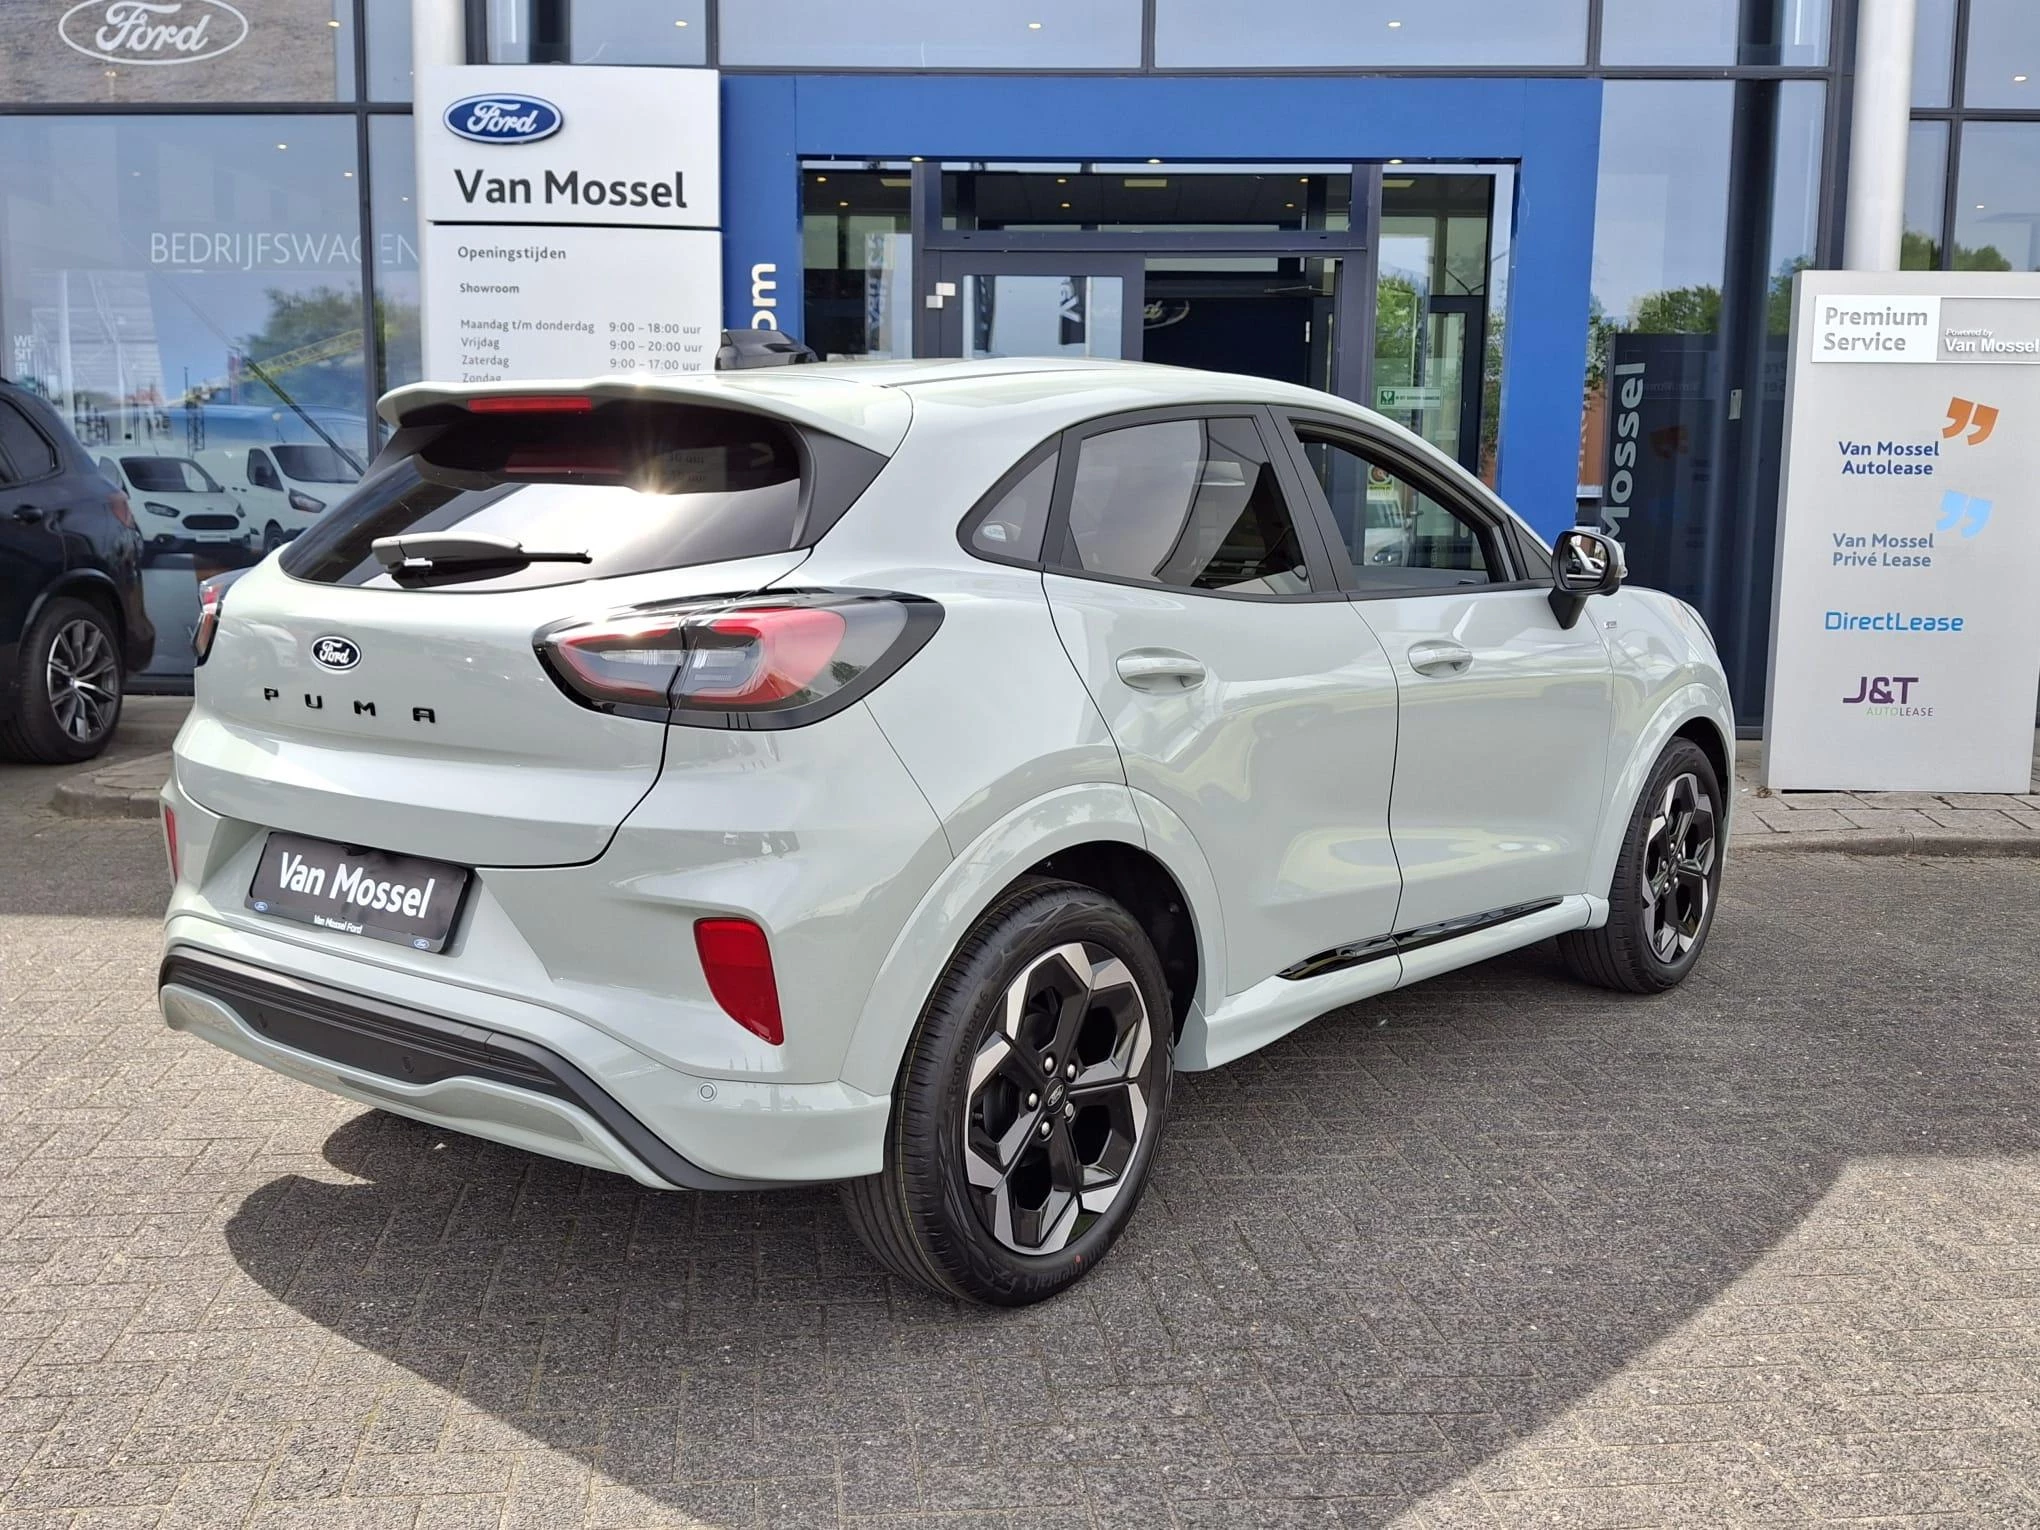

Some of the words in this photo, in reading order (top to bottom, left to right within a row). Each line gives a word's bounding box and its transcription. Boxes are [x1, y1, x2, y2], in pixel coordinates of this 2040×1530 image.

[96, 1, 212, 51] Ford
[467, 102, 539, 133] Ford
[454, 169, 531, 204] Van
[545, 170, 688, 208] Mossel
[457, 246, 567, 263] Openingstijden
[459, 282, 520, 294] Showroom
[1825, 306, 1928, 326] Premium
[460, 319, 509, 332] Maandag
[512, 320, 532, 330] t/m
[535, 320, 595, 334] donderdag
[609, 321, 635, 332] 9:00
[649, 323, 680, 334] 18:00
[683, 325, 702, 334] uur
[1945, 328, 1981, 337] Powered
[1983, 328, 1993, 338] by
[460, 337, 500, 350] Vrijdag
[609, 340, 635, 350] 9:00
[648, 341, 681, 352] 20:00
[684, 344, 703, 352] uur
[1823, 332, 1906, 351] Service
[1945, 338, 1976, 352] Van
[1981, 338, 2040, 353] Mossel
[461, 355, 510, 368] Zaterdag
[610, 358, 636, 368] 9:00
[649, 360, 679, 370] 17:00
[682, 362, 702, 371] uur
[1601, 362, 1646, 551] Mossel
[1838, 441, 1872, 456] Van
[1877, 441, 1940, 457] Mossel
[1842, 460, 1934, 475] Autolease
[1832, 533, 1867, 548] Van
[1872, 533, 1934, 549] Mossel
[1832, 552, 1877, 567] Privé
[1882, 553, 1932, 567] Lease
[1825, 611, 1964, 632] DirectLease
[319, 640, 350, 664] Ford
[1842, 676, 1919, 705] J&T
[263, 687, 436, 724] PUMA
[1866, 706, 1934, 717] AUTOLEASE
[280, 851, 325, 897] Van
[329, 862, 435, 919] Mossel
